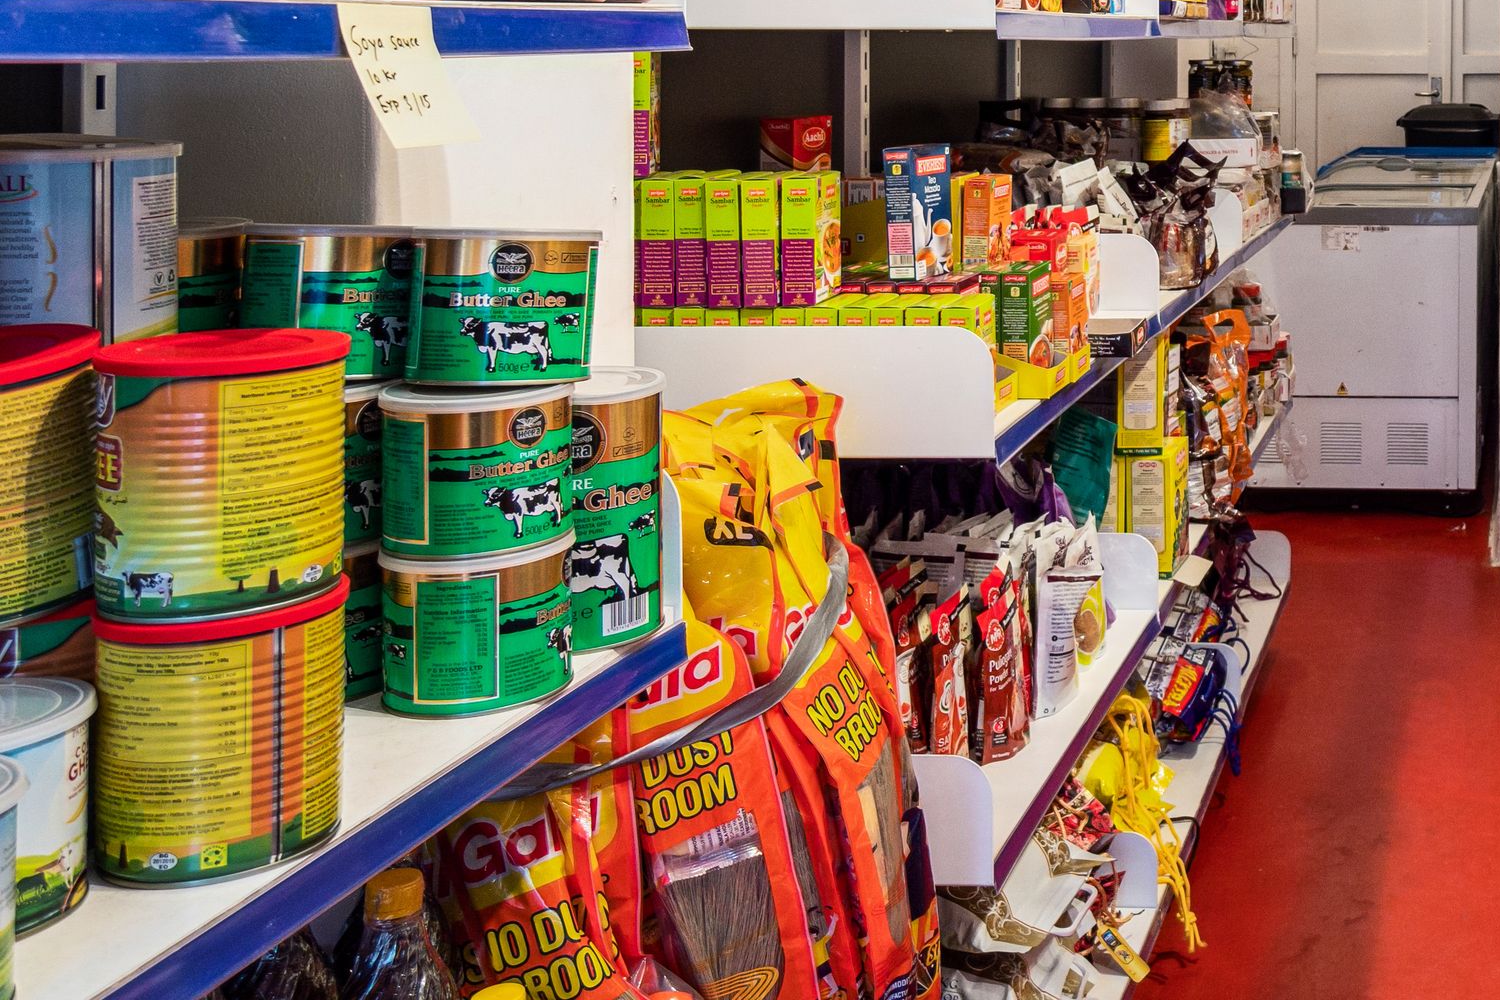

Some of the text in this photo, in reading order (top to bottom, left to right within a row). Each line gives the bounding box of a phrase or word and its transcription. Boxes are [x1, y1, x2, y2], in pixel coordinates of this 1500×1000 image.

[351, 25, 383, 61] Soya
[449, 292, 567, 308] Butter Ghee
[499, 286, 521, 294] PURE
[519, 449, 540, 459] PURE
[469, 457, 534, 480] Butter
[585, 483, 651, 512] Ghee
[807, 684, 845, 737] NO
